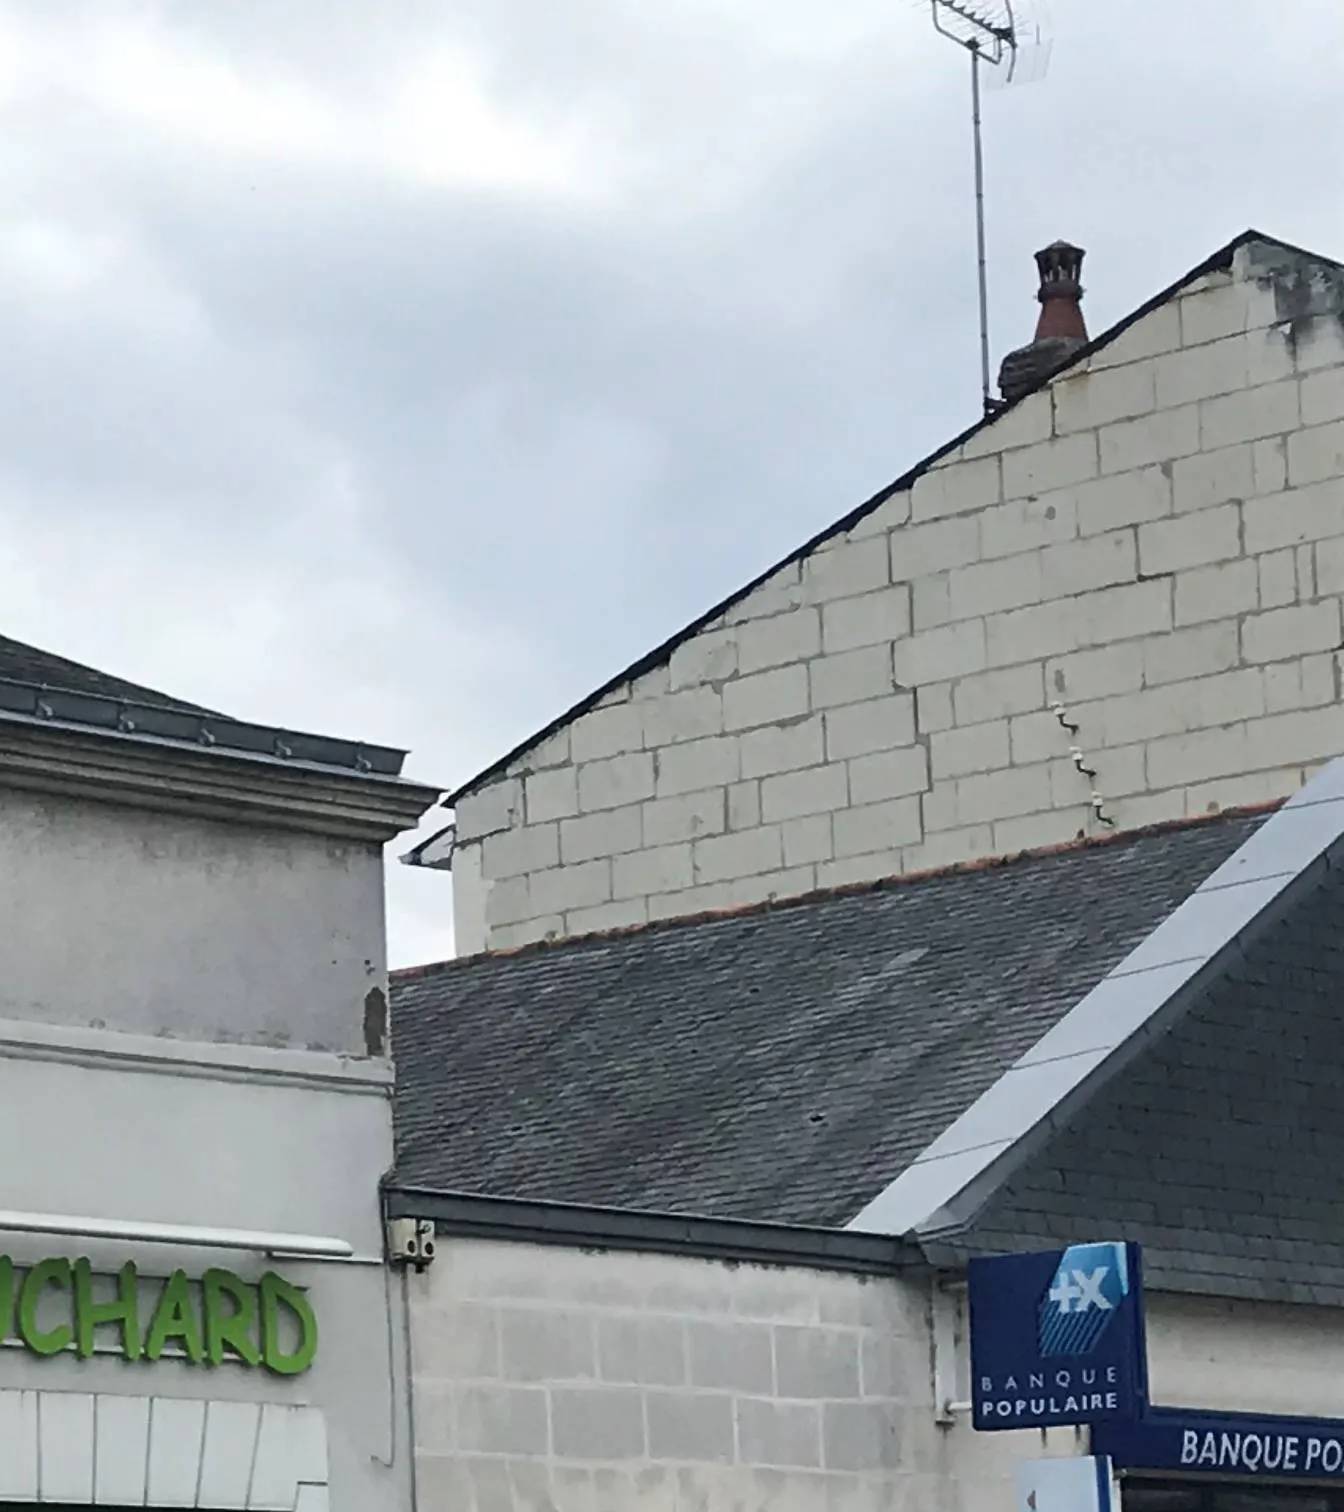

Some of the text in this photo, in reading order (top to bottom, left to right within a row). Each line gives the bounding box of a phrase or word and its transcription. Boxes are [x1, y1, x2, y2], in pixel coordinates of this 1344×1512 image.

[981, 1366, 1117, 1391] BANQUE
[982, 1392, 1117, 1416] POPULAIRE
[1181, 1430, 1343, 1472] BANQUE PO
